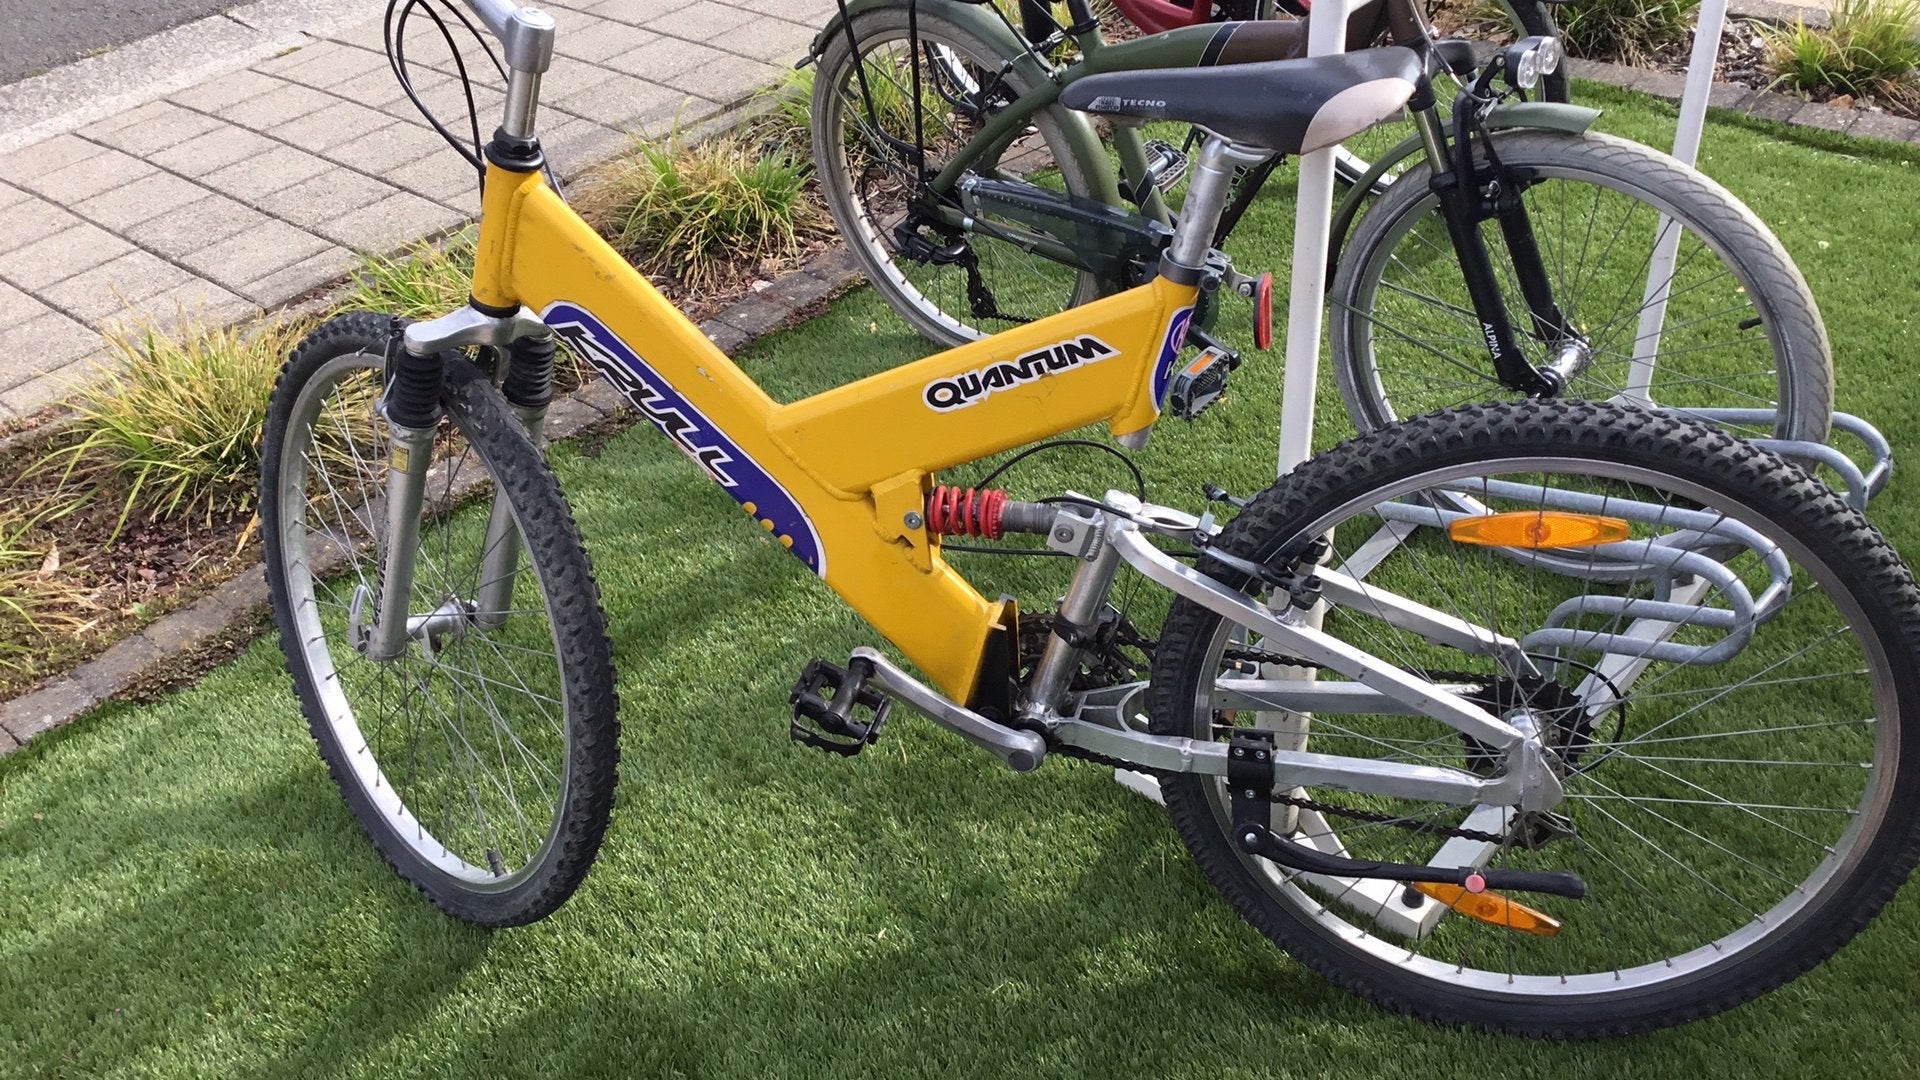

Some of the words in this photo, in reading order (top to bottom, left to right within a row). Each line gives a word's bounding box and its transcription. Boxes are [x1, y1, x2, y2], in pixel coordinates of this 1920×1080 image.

[1122, 99, 1167, 108] TECNO
[1482, 322, 1502, 360] ALPINA
[924, 336, 1115, 410] QUANTUM
[554, 322, 737, 486] KRULL
